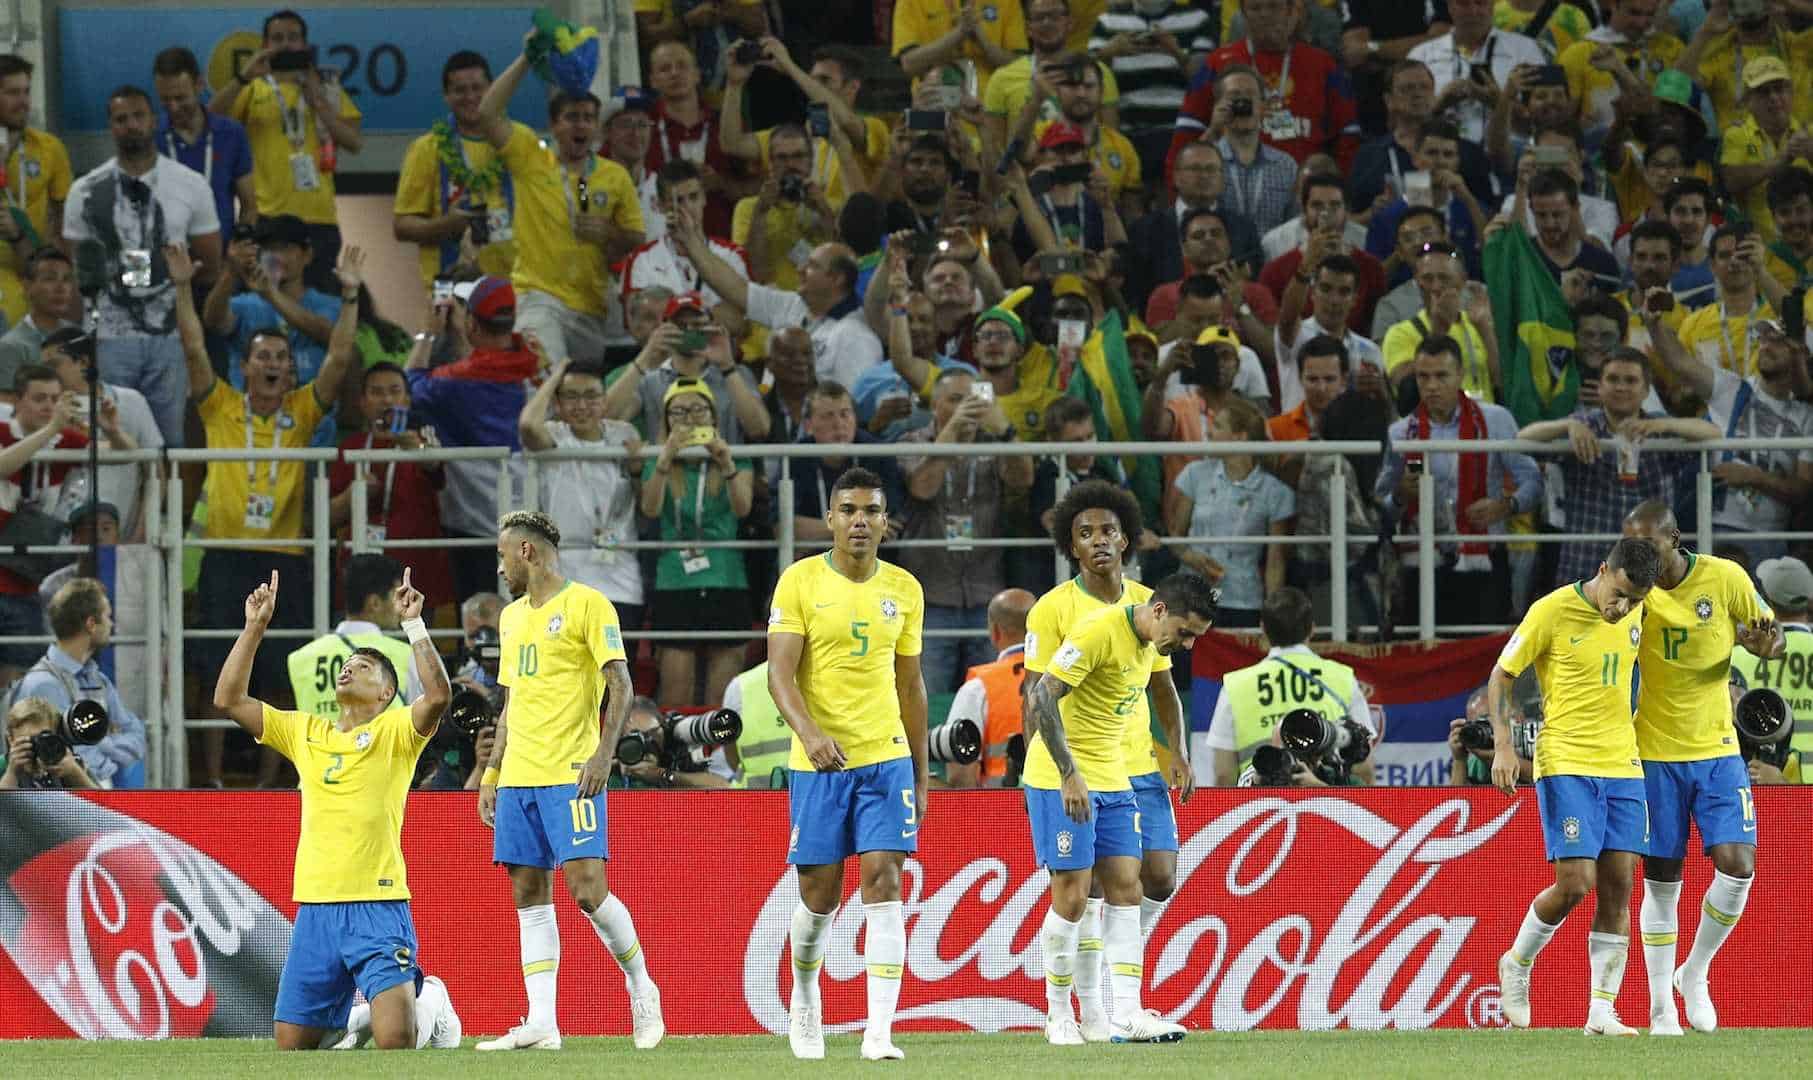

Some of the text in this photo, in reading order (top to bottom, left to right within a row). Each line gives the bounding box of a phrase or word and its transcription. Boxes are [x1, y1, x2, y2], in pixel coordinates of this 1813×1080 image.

[851, 621, 870, 657] 5
[1662, 627, 1688, 660] 17
[518, 643, 538, 677] 10
[1602, 653, 1619, 686] 11
[1257, 667, 1324, 706] 5105
[324, 753, 343, 785] 2
[568, 798, 597, 833] 10
[901, 789, 916, 825] 5
[1102, 797, 1520, 1031] Cola
